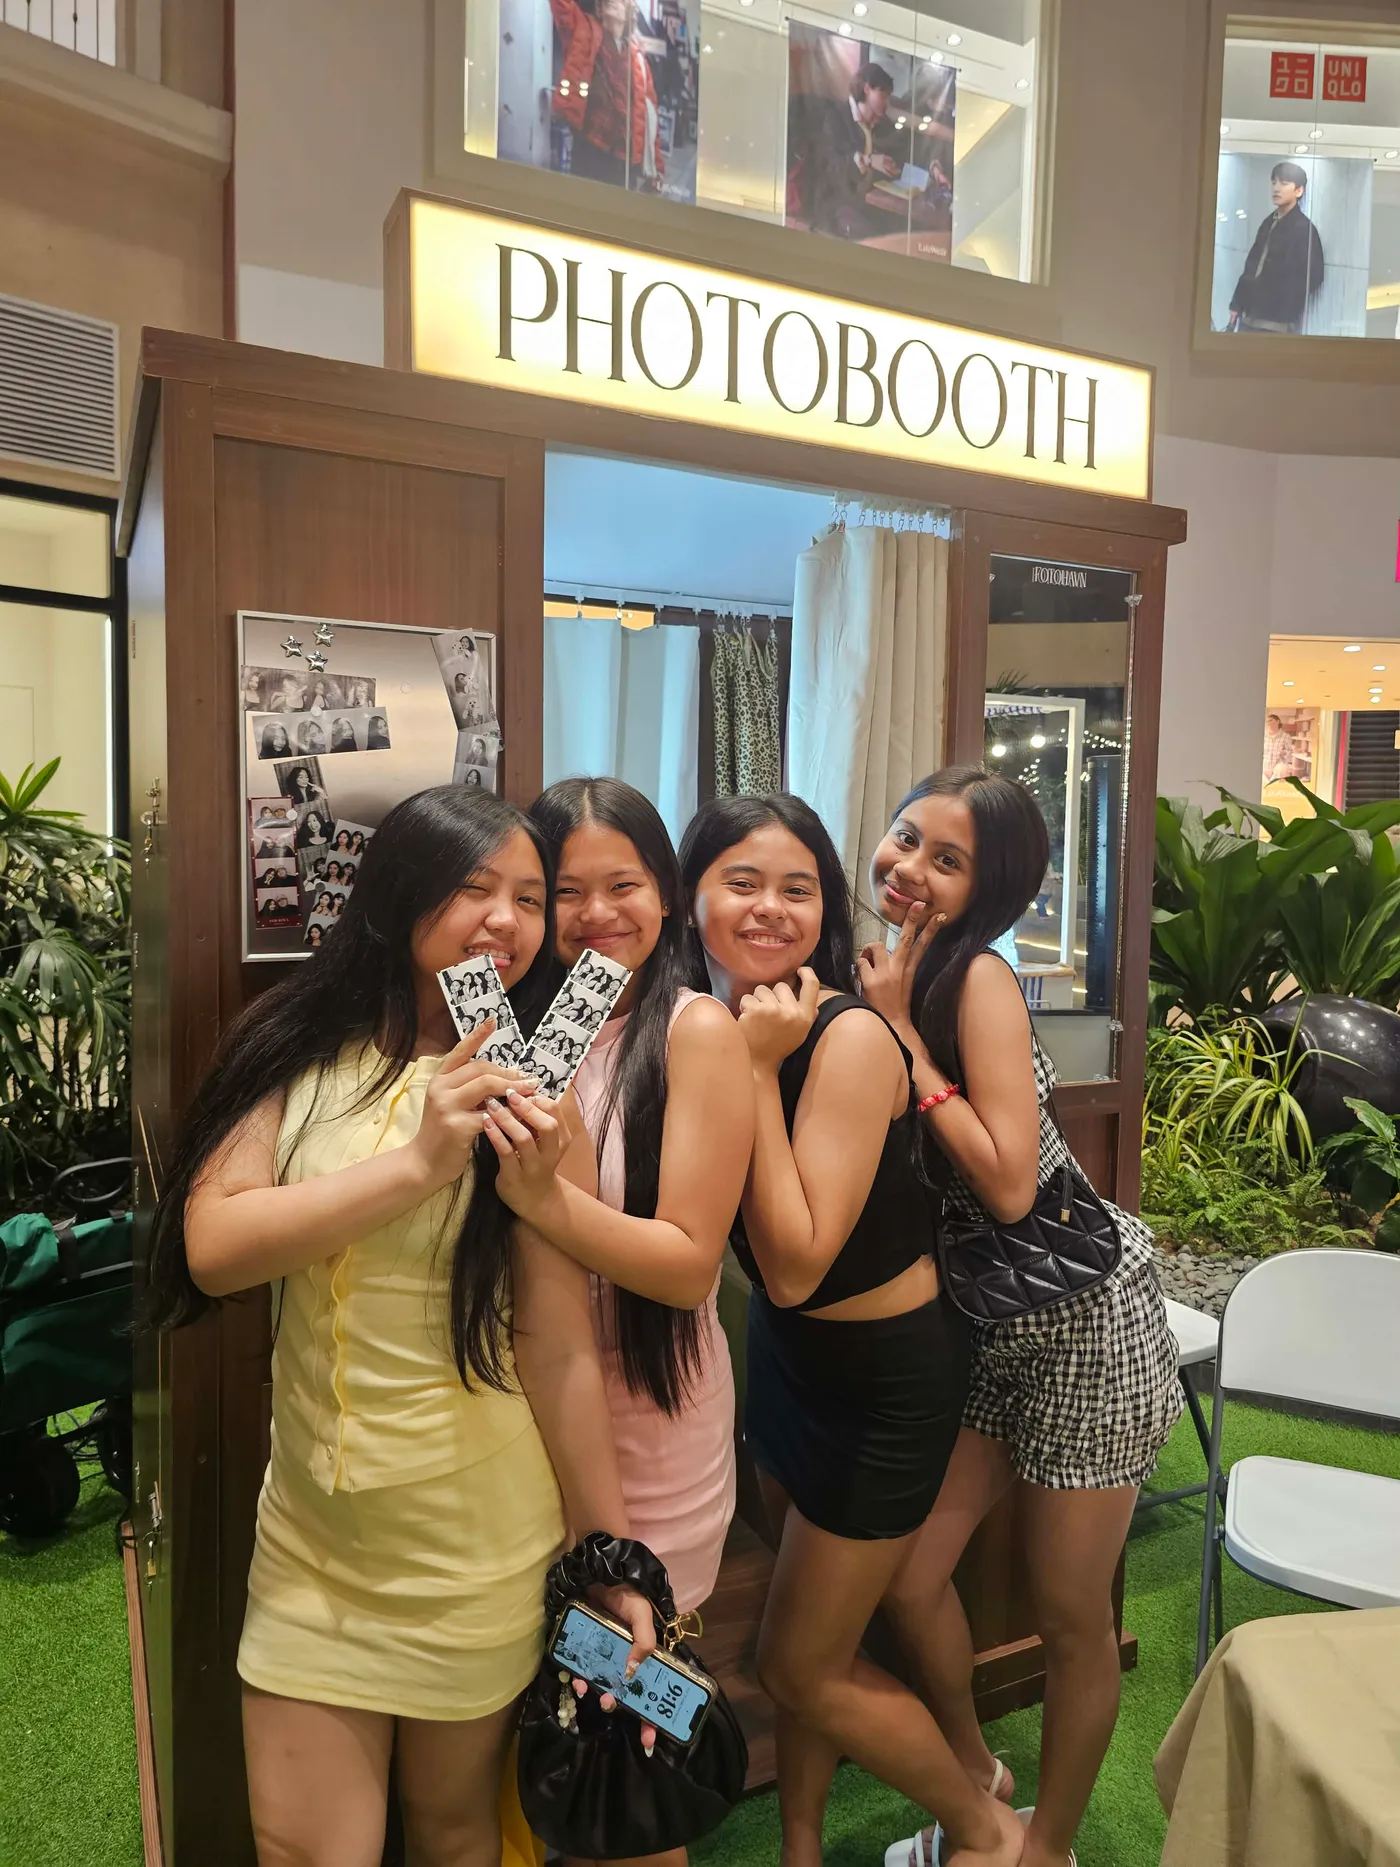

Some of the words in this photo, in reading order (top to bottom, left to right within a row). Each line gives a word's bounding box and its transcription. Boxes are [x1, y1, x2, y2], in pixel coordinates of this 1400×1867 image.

[1276, 57, 1309, 74] ユニ
[1328, 60, 1360, 77] UNI
[1274, 77, 1308, 94] クロ
[1327, 79, 1361, 98] QLO
[495, 243, 1099, 470] PHOTOBOOTH
[656, 1680, 683, 1719] 9:18
